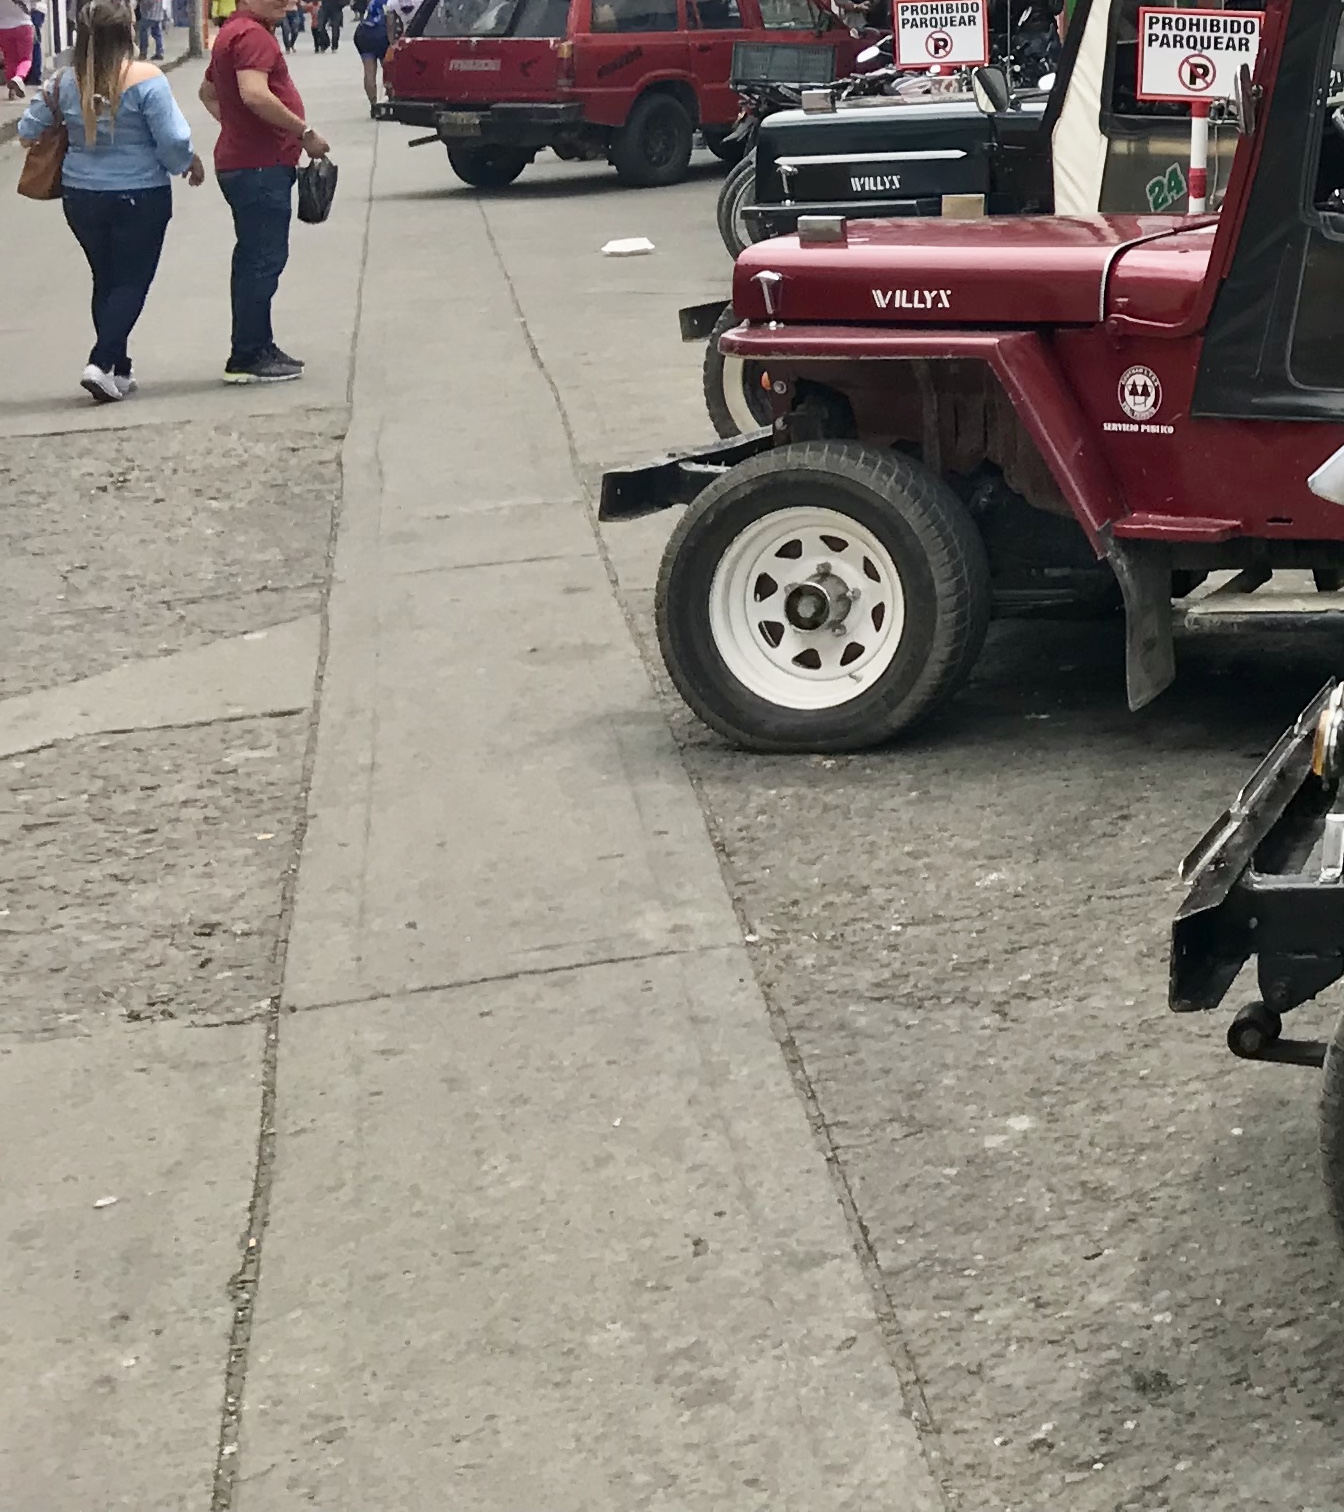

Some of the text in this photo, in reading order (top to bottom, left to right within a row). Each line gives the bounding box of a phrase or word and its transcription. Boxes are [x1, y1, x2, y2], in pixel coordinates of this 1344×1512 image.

[901, 2, 979, 16] PROHIBIDO
[902, 15, 977, 29] PARQUEAR
[1148, 16, 1255, 35] PROHIBIDO
[1148, 33, 1250, 52] PARQUEAR
[850, 175, 901, 191] WILLYS
[1146, 163, 1187, 212] 24
[872, 289, 952, 309] WILLYS
